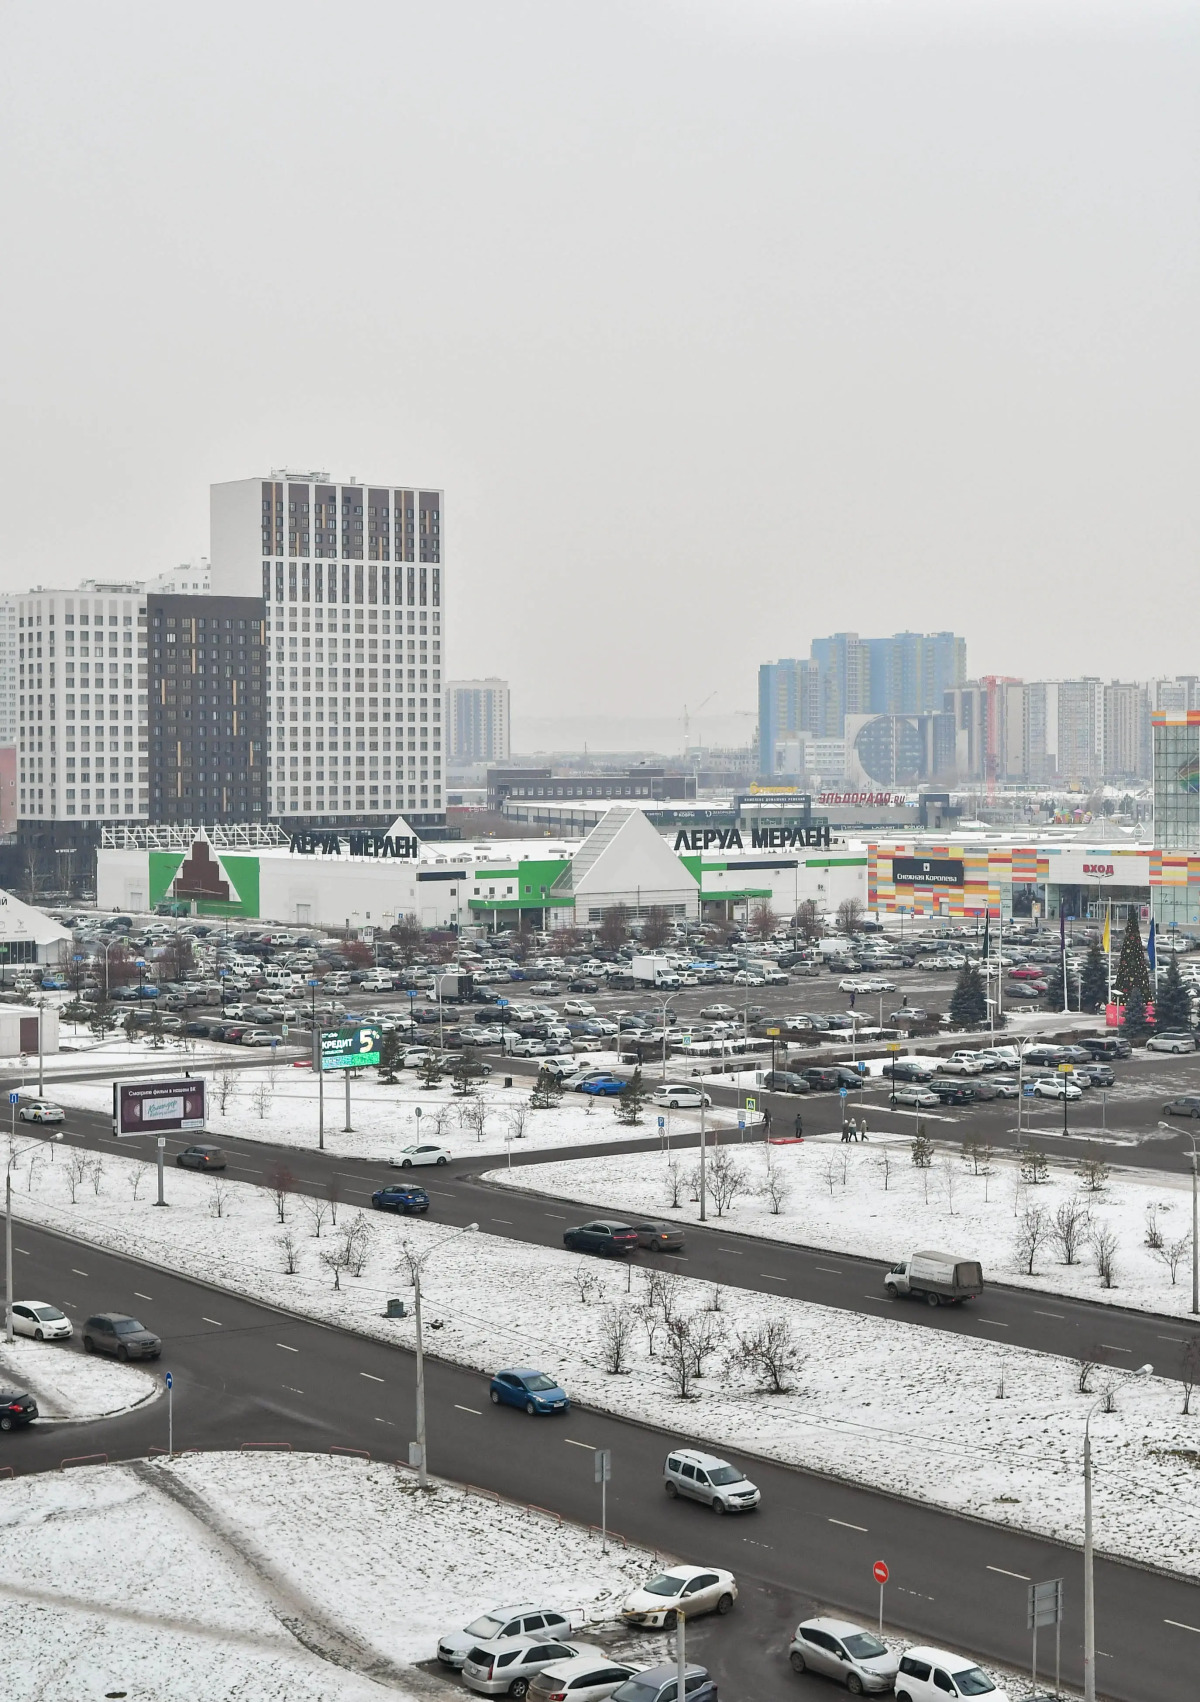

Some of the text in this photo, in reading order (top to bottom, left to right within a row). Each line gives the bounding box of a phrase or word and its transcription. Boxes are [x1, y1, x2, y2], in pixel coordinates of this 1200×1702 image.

[290, 832, 418, 858] ЛЕРУА МЕРЛЕН
[674, 827, 830, 850] ЛЕРУА МЕРЛЕН
[1082, 864, 1114, 876] ВХОД
[322, 1038, 354, 1050] КРЕДИТ
